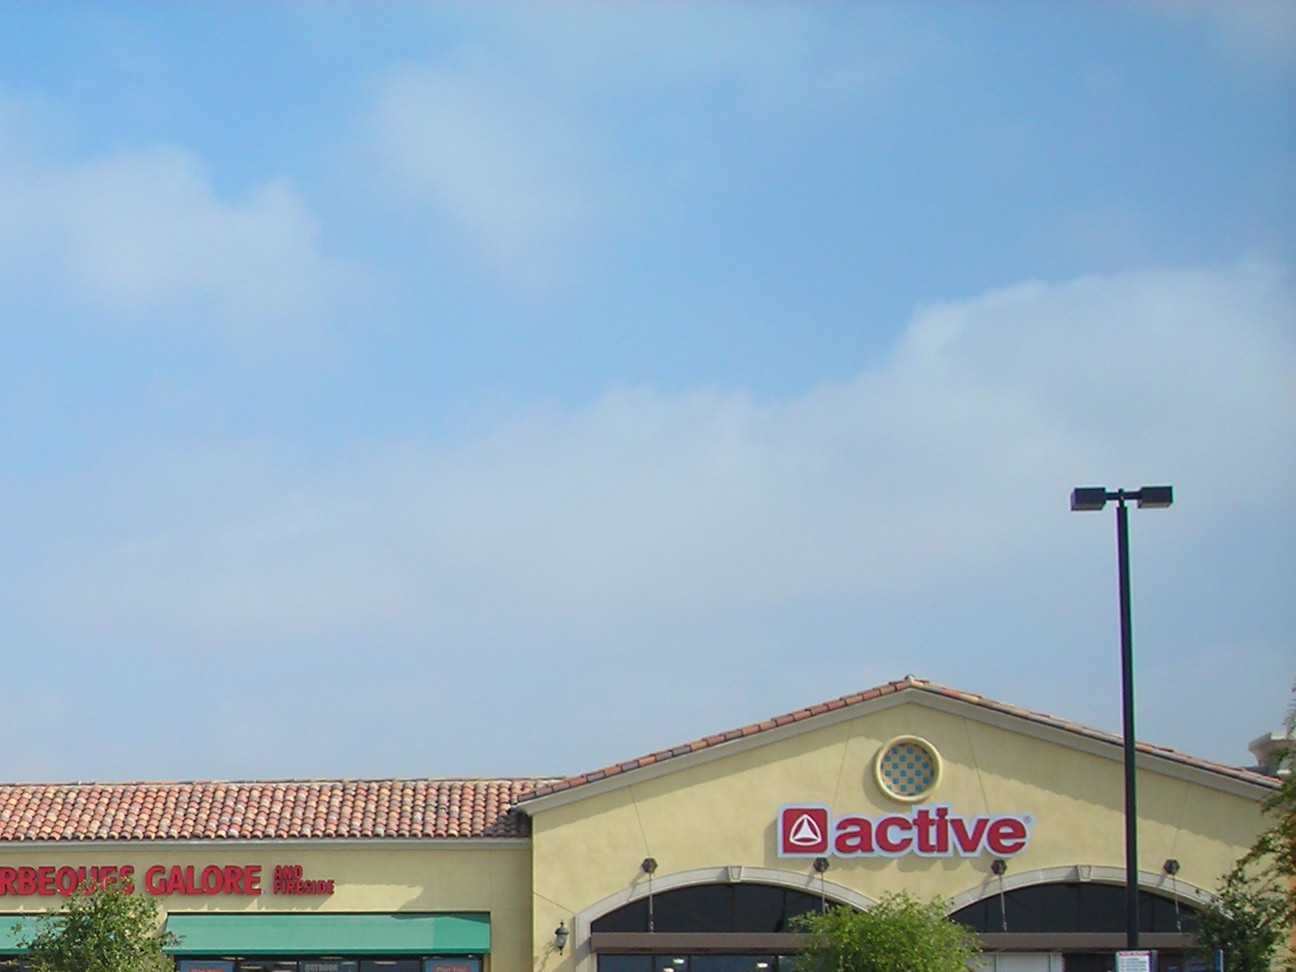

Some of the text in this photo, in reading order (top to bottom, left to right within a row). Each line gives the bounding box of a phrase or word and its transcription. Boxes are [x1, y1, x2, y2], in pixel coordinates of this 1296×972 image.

[835, 807, 1028, 855] active
[145, 864, 264, 896] GALORE
[273, 864, 303, 879] AND
[273, 879, 336, 895] FIRESIDE
